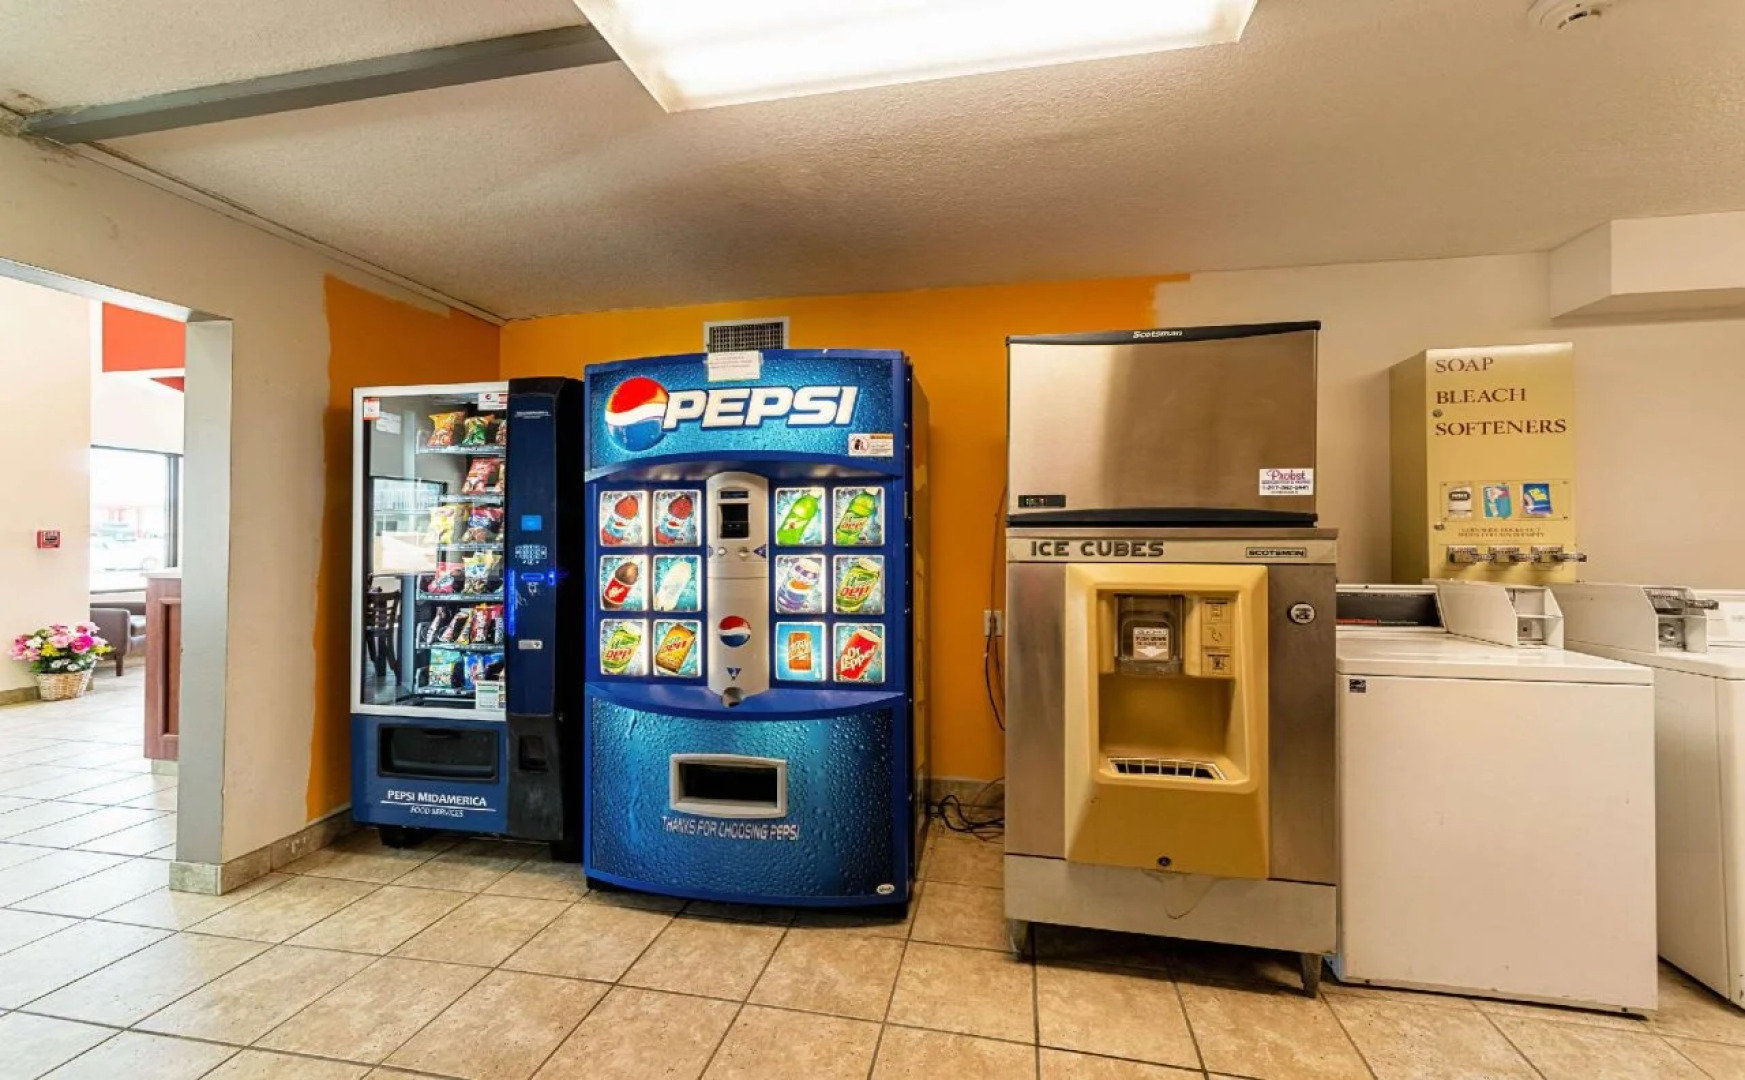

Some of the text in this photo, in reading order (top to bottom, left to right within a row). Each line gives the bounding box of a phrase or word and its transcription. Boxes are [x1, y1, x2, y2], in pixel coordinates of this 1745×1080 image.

[1132, 330, 1183, 339] Scotsman
[1435, 357, 1494, 373] SOAP
[1436, 388, 1526, 404] BLEACH
[662, 385, 858, 429] PEPSI
[1435, 419, 1567, 436] SOFTENERS
[1266, 469, 1305, 481] Probst
[1031, 541, 1164, 557] ICE CUBES
[387, 790, 415, 801] PEPSI
[410, 805, 430, 815] FOOD
[662, 816, 800, 841] THANKS FOR CHOOSING PEPSI
